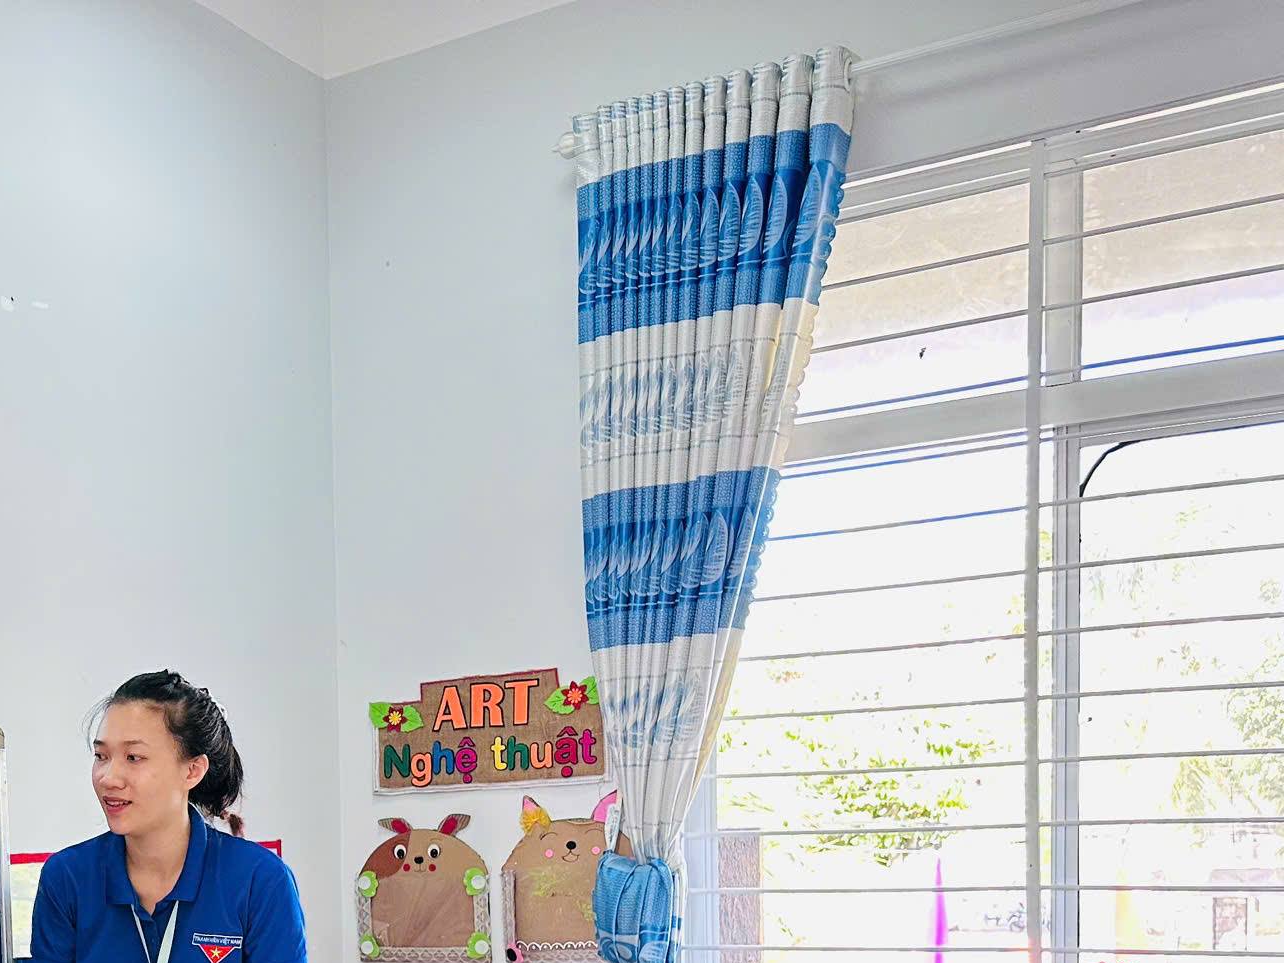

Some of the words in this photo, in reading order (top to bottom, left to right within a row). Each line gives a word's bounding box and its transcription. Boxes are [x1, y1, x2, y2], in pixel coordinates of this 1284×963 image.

[432, 678, 539, 732] ART
[383, 737, 478, 787] Nghệ
[490, 725, 597, 778] thuật
